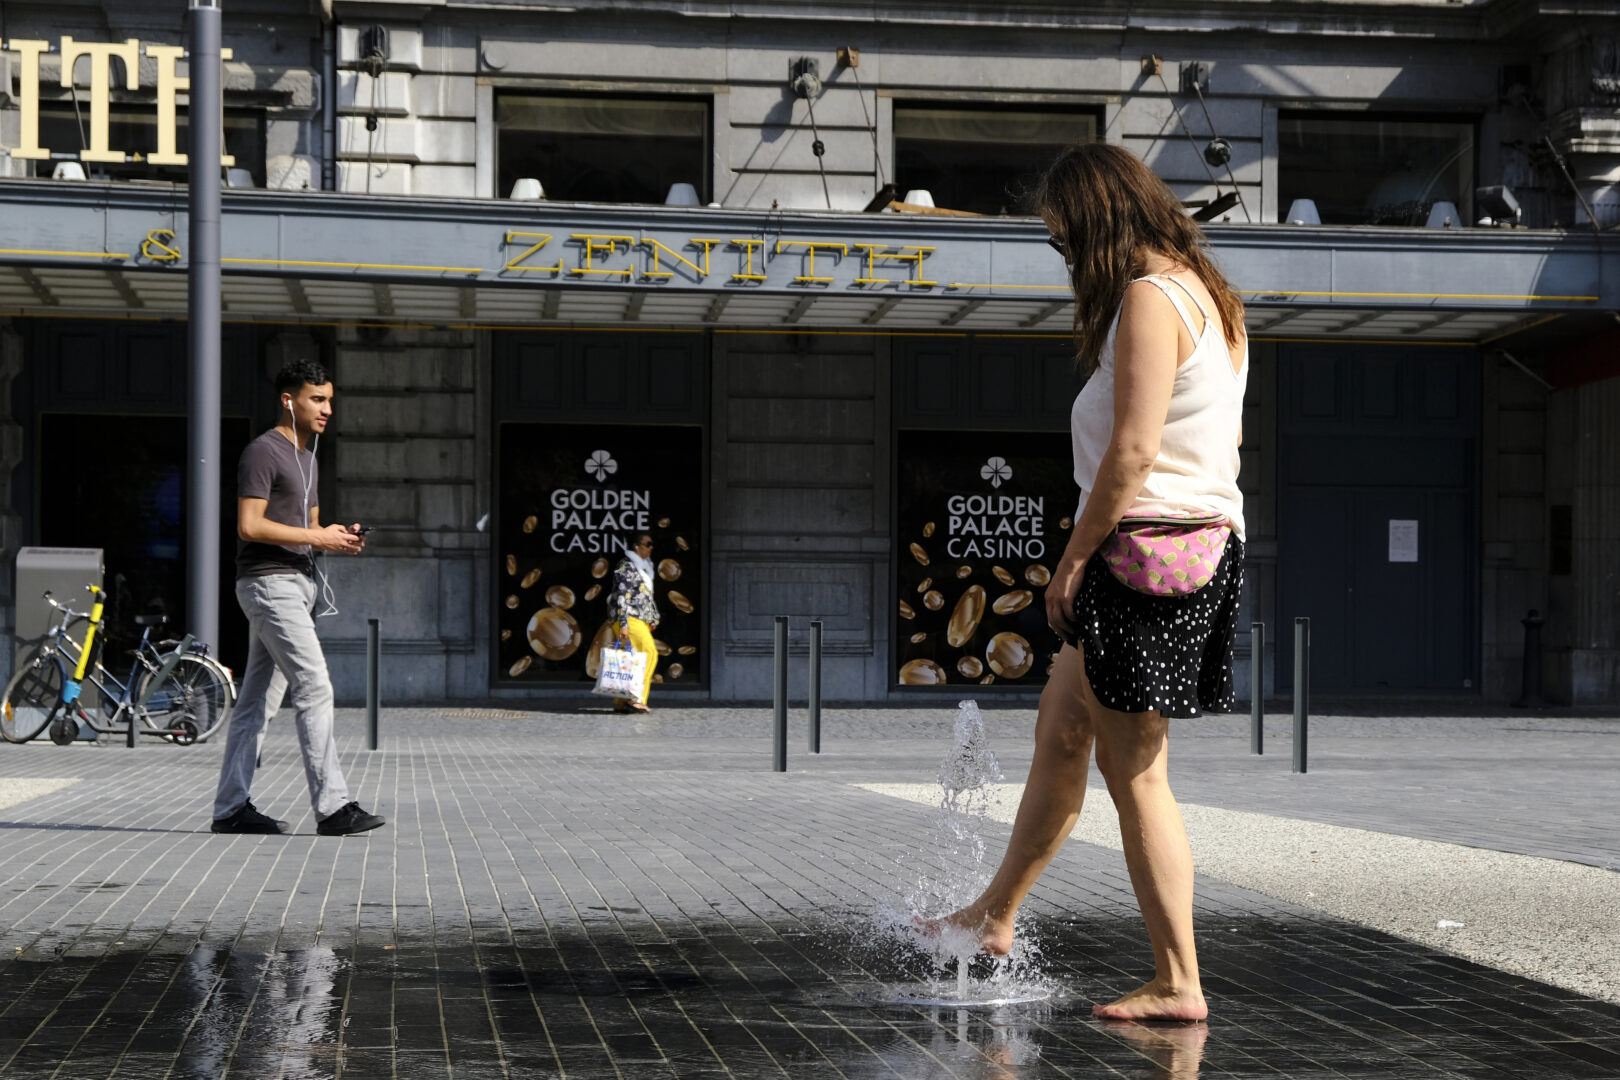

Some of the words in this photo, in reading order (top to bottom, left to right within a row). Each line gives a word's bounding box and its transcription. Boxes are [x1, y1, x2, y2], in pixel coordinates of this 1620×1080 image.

[506, 231, 938, 285] ZENITH
[551, 489, 650, 510] GOLDEN
[947, 496, 1044, 516] GOLDEN
[552, 510, 650, 531] PALACE
[949, 516, 1044, 536] PALACE
[551, 533, 628, 553] CASIN
[948, 538, 1045, 559] CASINO
[603, 671, 634, 681] ACTION
